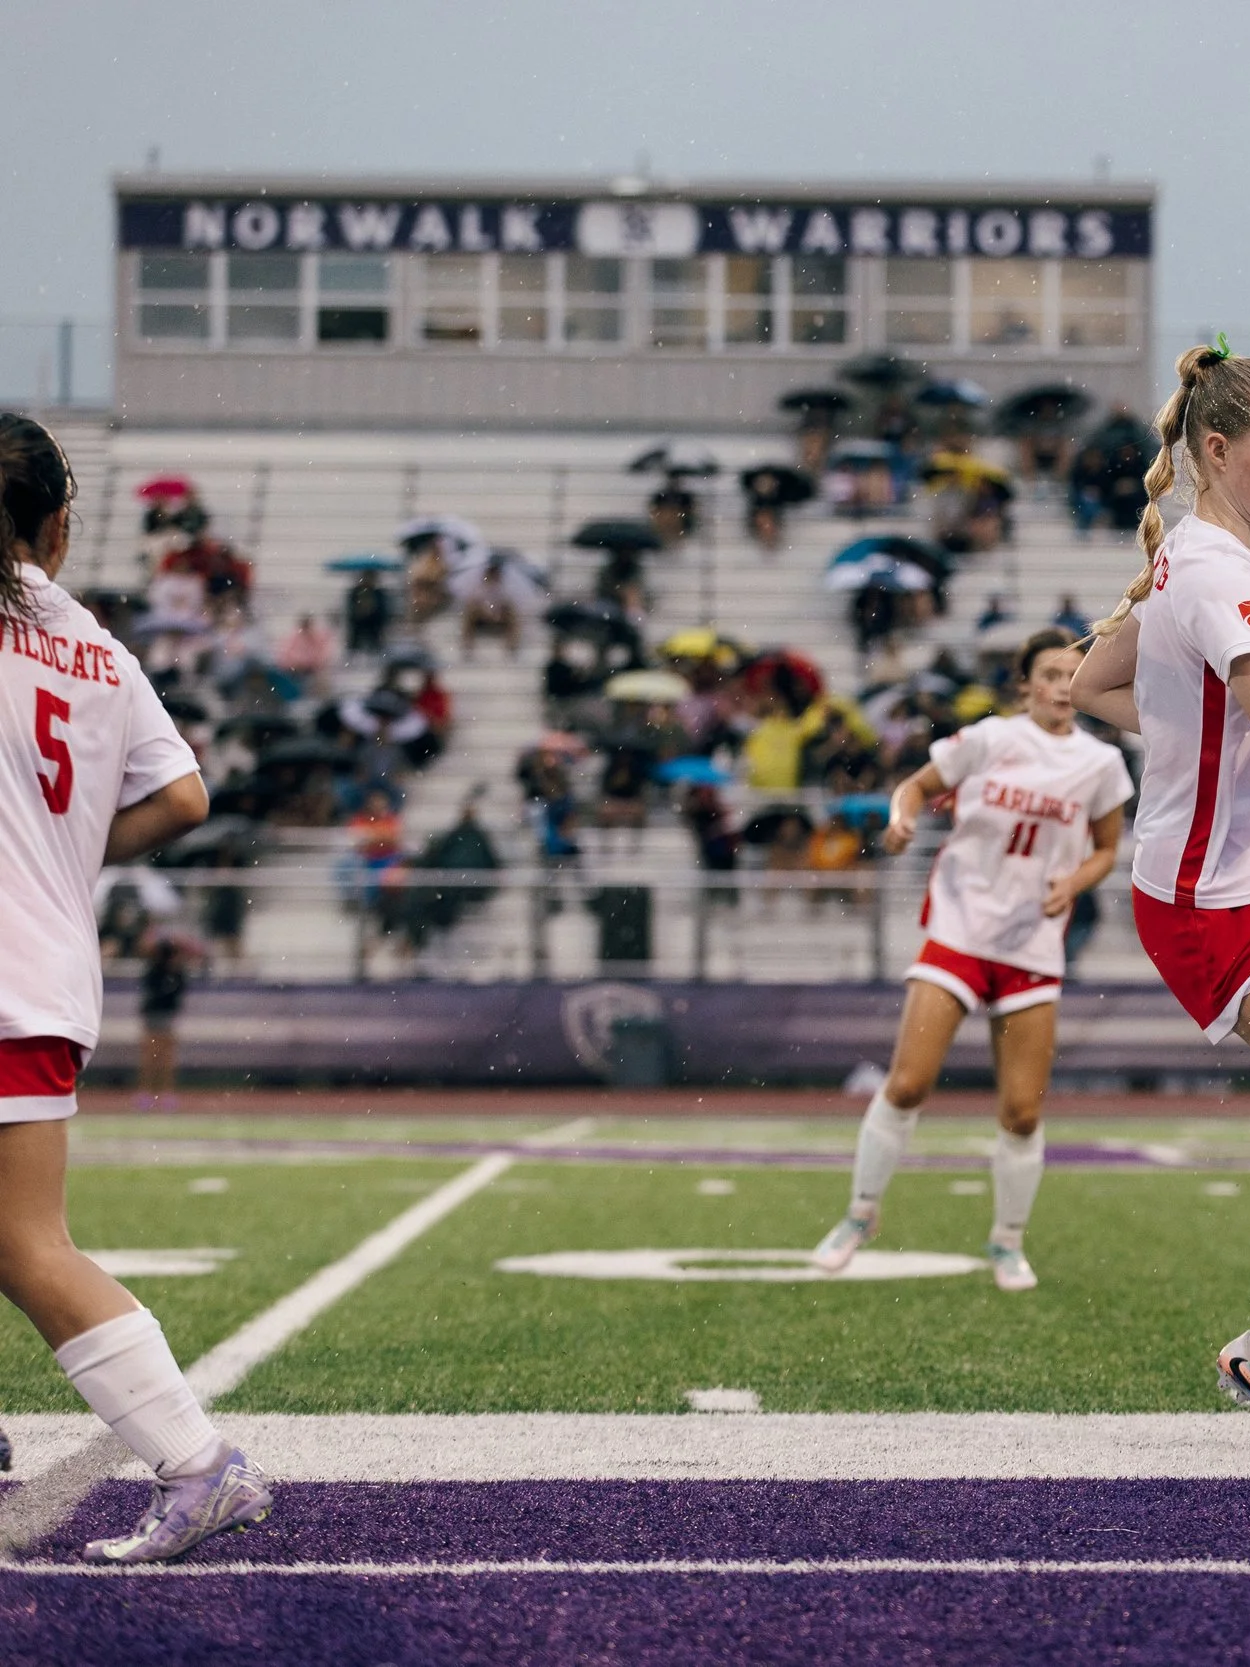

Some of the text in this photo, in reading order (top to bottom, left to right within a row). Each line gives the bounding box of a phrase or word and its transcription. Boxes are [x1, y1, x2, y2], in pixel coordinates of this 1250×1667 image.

[183, 203, 1114, 257] NORWALK WARRIORS
[35, 686, 73, 815] 5
[1005, 821, 1039, 857] 11
